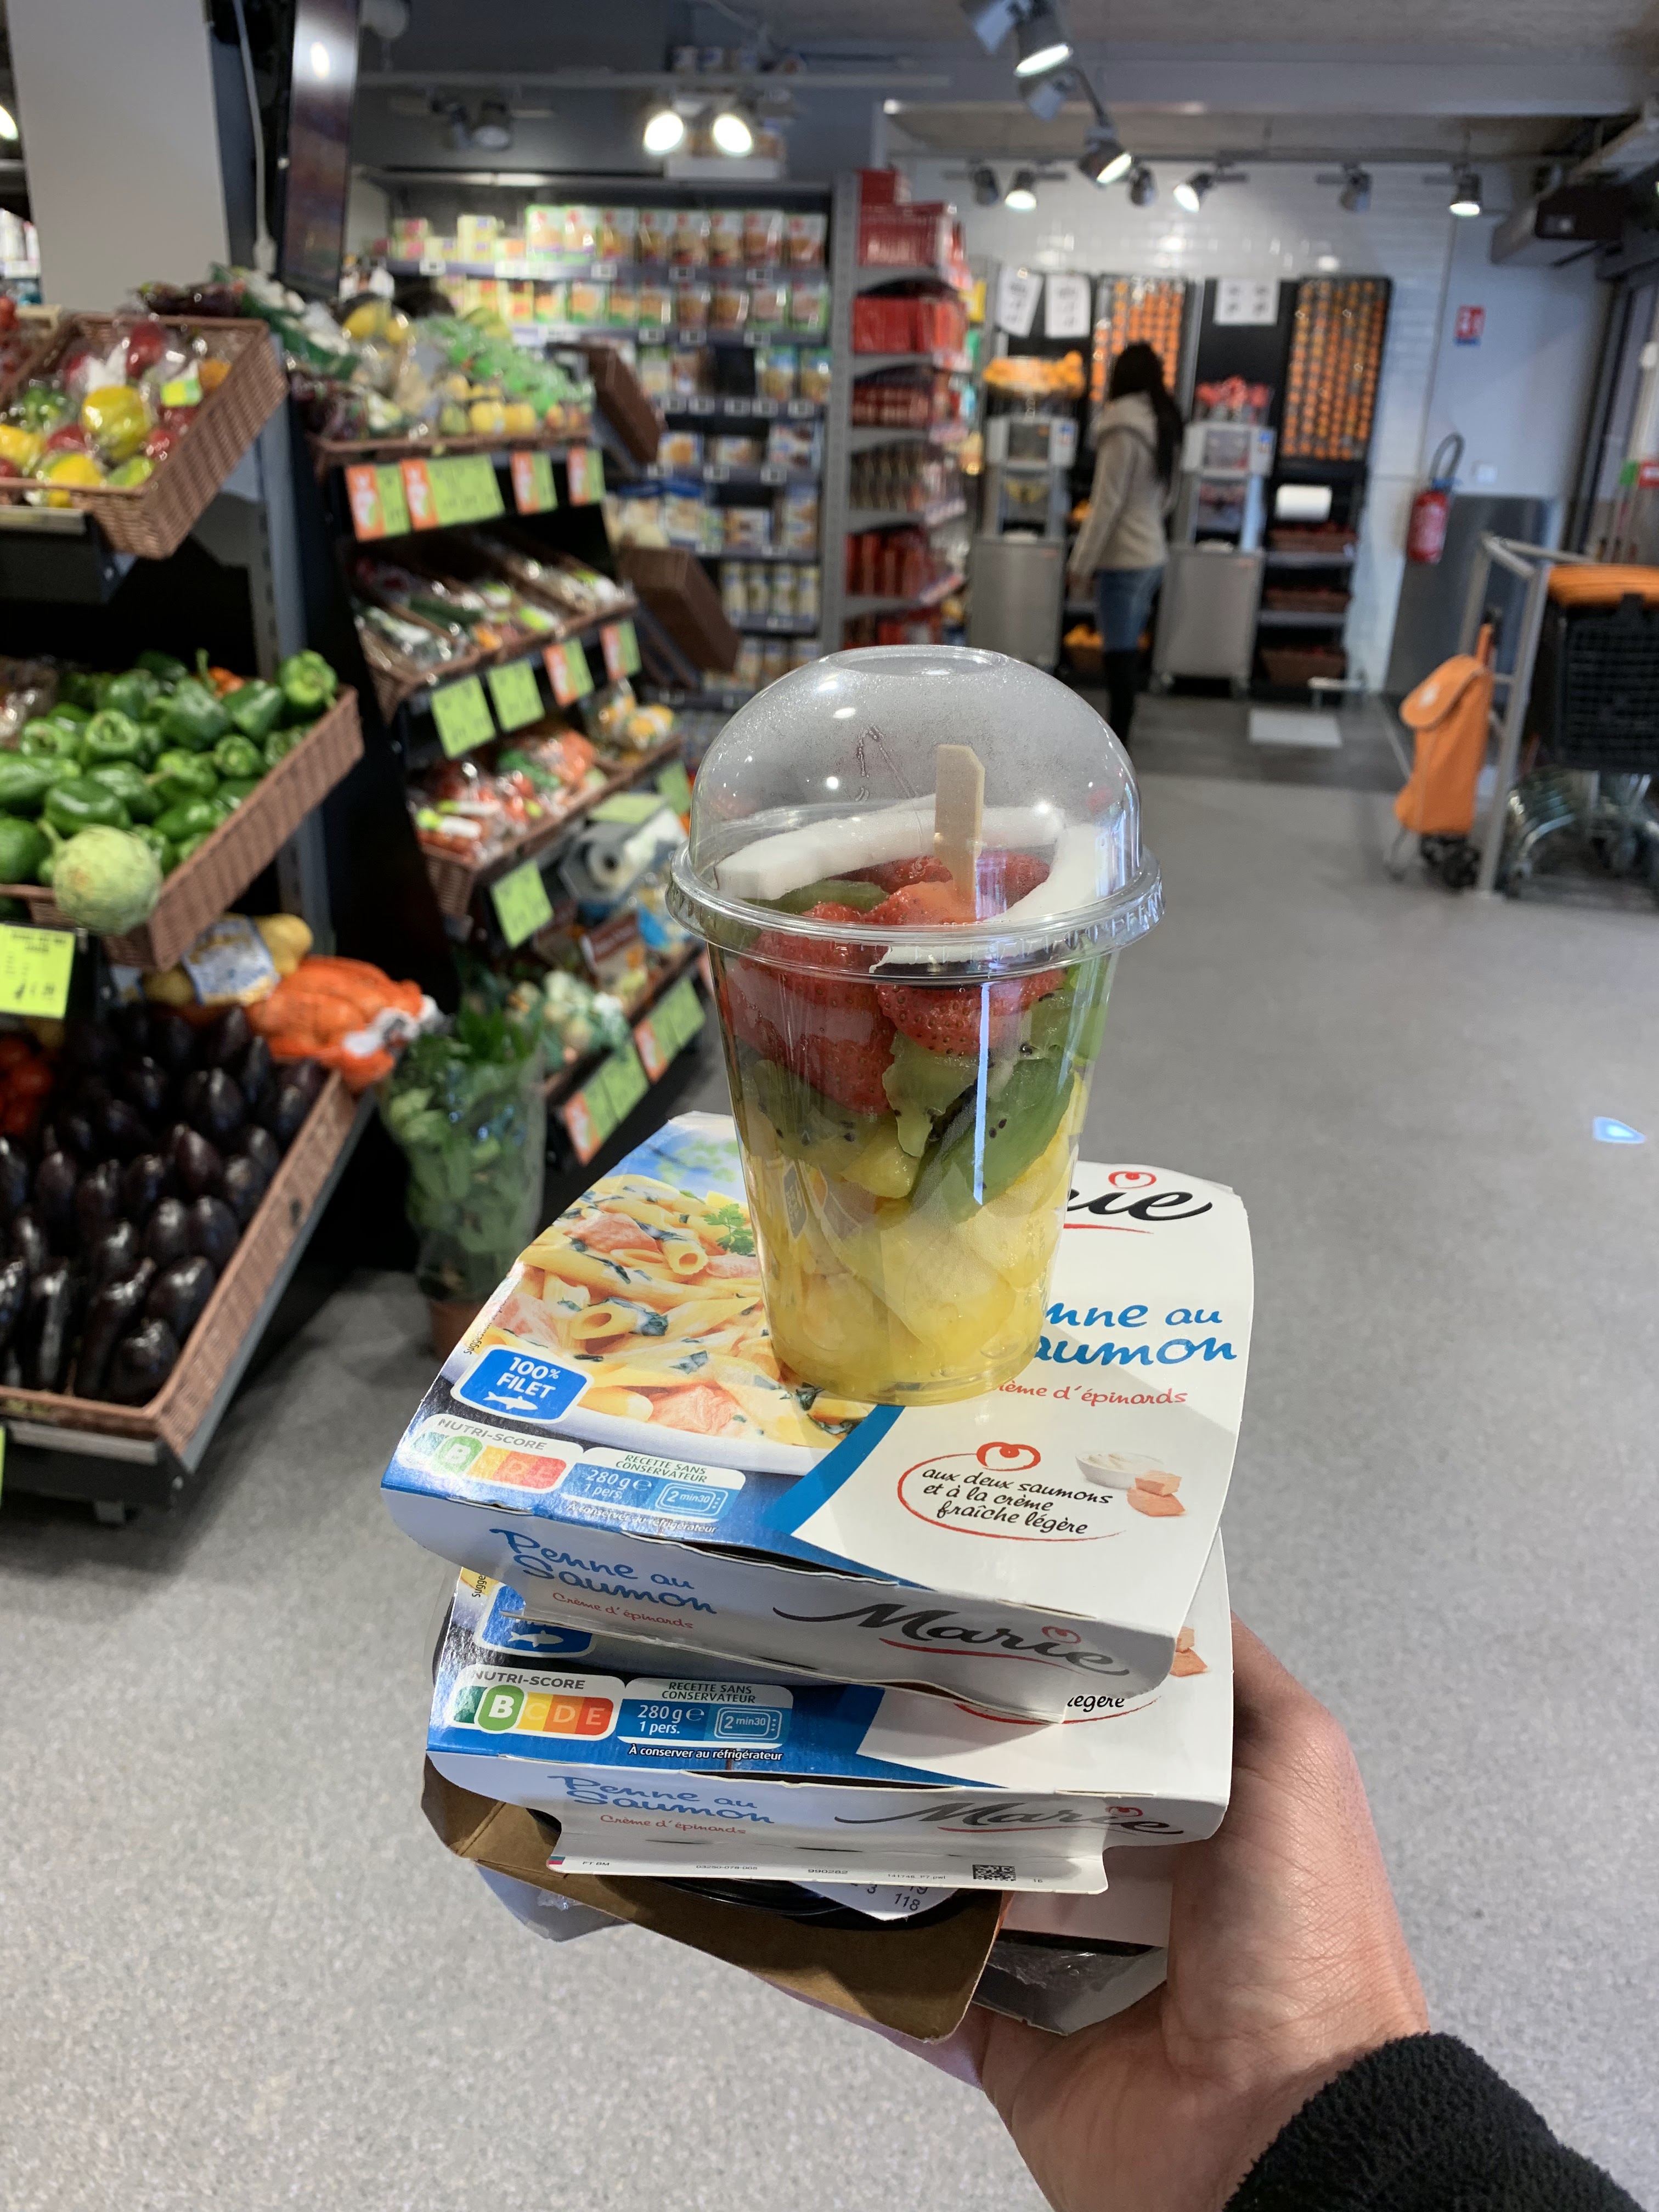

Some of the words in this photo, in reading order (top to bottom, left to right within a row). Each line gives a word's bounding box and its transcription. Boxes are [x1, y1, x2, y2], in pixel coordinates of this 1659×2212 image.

[1165, 1308, 1223, 1326] au
[1035, 1335, 1238, 1366] aumon
[509, 1357, 561, 1380] 100%
[496, 1372, 556, 1398] FILET
[437, 1418, 548, 1451] NUTRI-SCORE
[615, 1460, 708, 1483] CONSERVATEUR
[624, 1454, 672, 1469] RECETTE
[675, 1463, 708, 1475] SANS
[583, 1483, 589, 1493] 1
[922, 1468, 961, 1481] aux
[963, 1471, 1014, 1489] deux
[1017, 1483, 1114, 1504] saumons
[923, 1483, 944, 1495] et
[946, 1485, 960, 1498] à
[966, 1488, 988, 1502] la
[994, 1494, 1054, 1511] crème
[579, 1505, 631, 1521] conserver
[648, 1517, 718, 1533] réfrigérateur
[936, 1500, 1020, 1524] fraîche
[1024, 1511, 1088, 1534] légère
[489, 1528, 638, 1579] Penne
[650, 1573, 695, 1589] au
[513, 1554, 718, 1615] Saumon
[552, 1592, 602, 1611] Crème
[772, 1602, 1130, 1677] Marie
[475, 1670, 586, 1690] NUTRI-SCORE
[668, 1681, 716, 1692] RECETTE
[720, 1684, 752, 1694] SANS
[661, 1690, 756, 1703] CONSERVATEUR
[488, 1694, 515, 1719] B
[524, 1702, 548, 1721] C
[552, 1705, 575, 1723] D
[585, 1707, 606, 1725] E
[640, 1721, 646, 1732] 1
[648, 1723, 680, 1735] pers.
[724, 1716, 734, 1729] 2
[628, 1743, 637, 1754] À
[640, 1748, 694, 1758] conserver
[695, 1750, 709, 1758] au
[713, 1748, 783, 1762] réfrigérateur
[547, 1775, 701, 1802] Penne
[713, 1797, 758, 1809] au
[566, 1789, 775, 1824] Saumon
[834, 1802, 1184, 1835] Marie
[599, 1814, 651, 1826] Crème
[894, 1893, 921, 1911] 118
